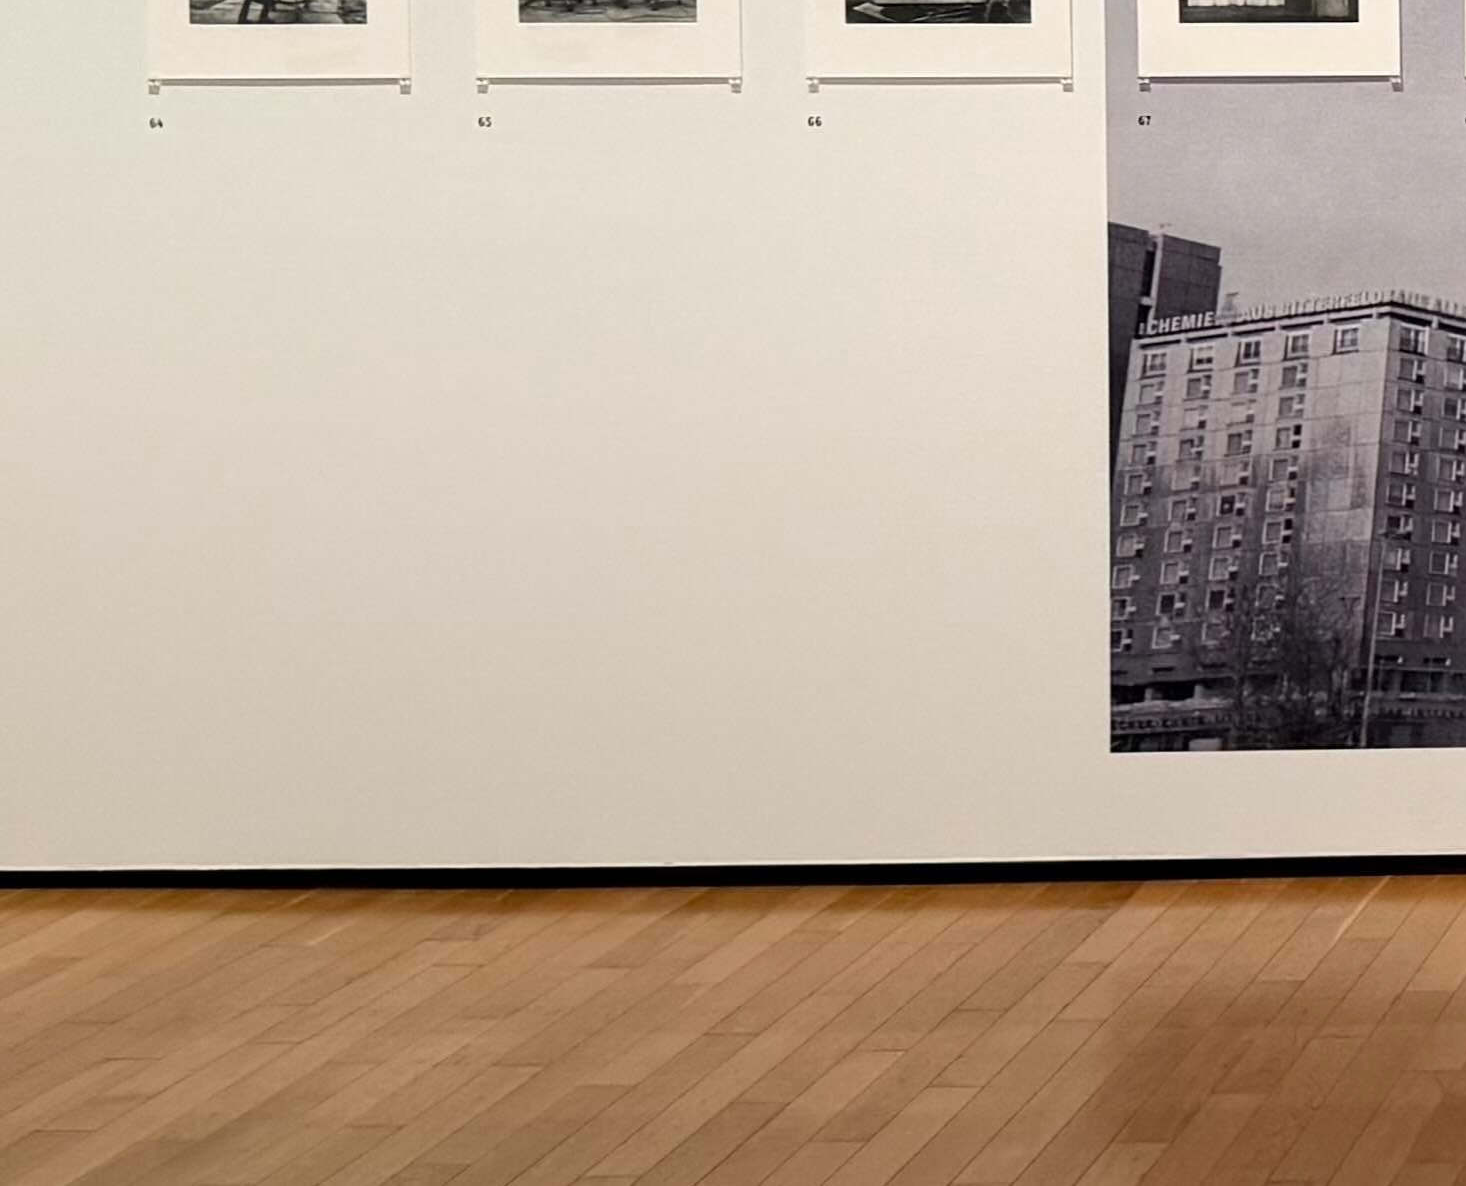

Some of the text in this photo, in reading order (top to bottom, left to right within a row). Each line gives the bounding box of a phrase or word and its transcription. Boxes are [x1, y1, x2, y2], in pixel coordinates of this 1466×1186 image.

[149, 117, 164, 129] 64
[477, 116, 493, 128] 65
[807, 115, 823, 127] 66
[1137, 115, 1152, 127] 67
[1146, 310, 1215, 335] CHEMIE
